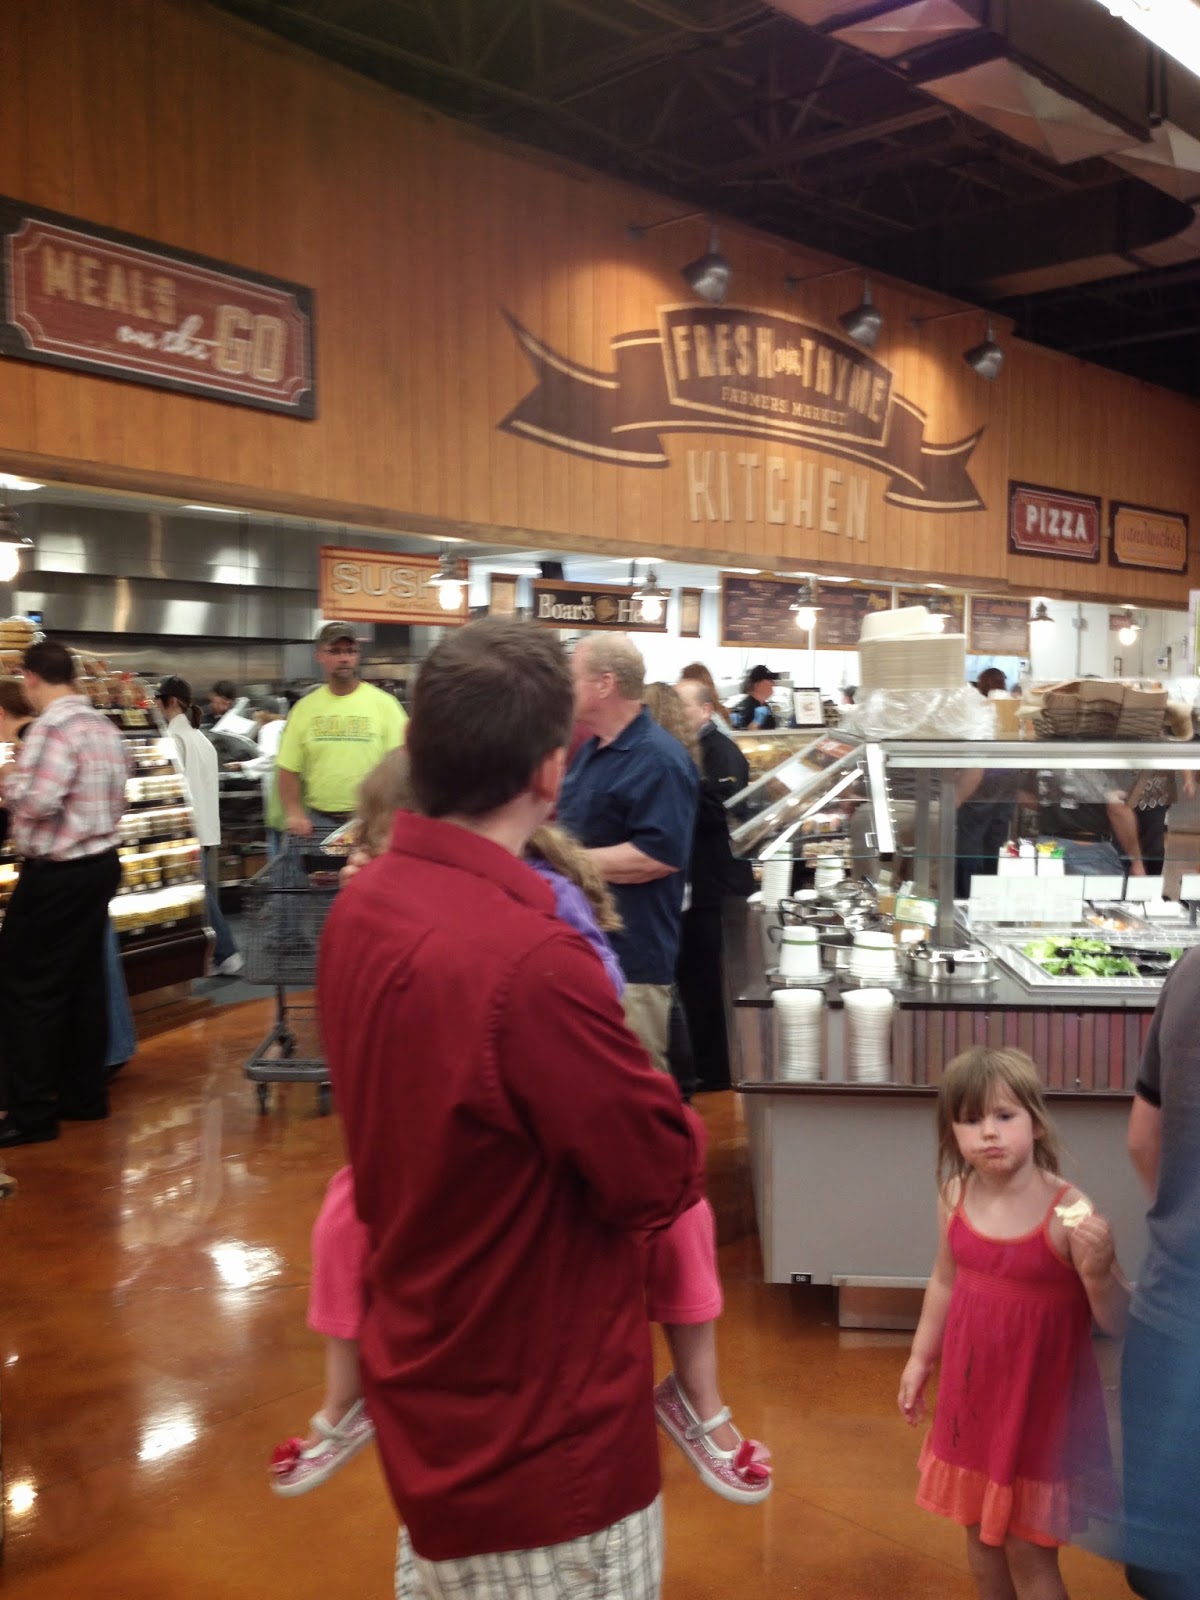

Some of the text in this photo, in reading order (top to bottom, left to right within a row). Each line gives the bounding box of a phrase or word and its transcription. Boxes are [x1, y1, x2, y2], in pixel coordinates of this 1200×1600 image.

[40, 246, 177, 325] MEALS
[212, 304, 289, 383] GO
[671, 323, 886, 424] FRESH THYME
[721, 386, 848, 426] FARMERS MARKET
[687, 449, 870, 542] KITCHEN
[1025, 504, 1088, 541] PIZZA
